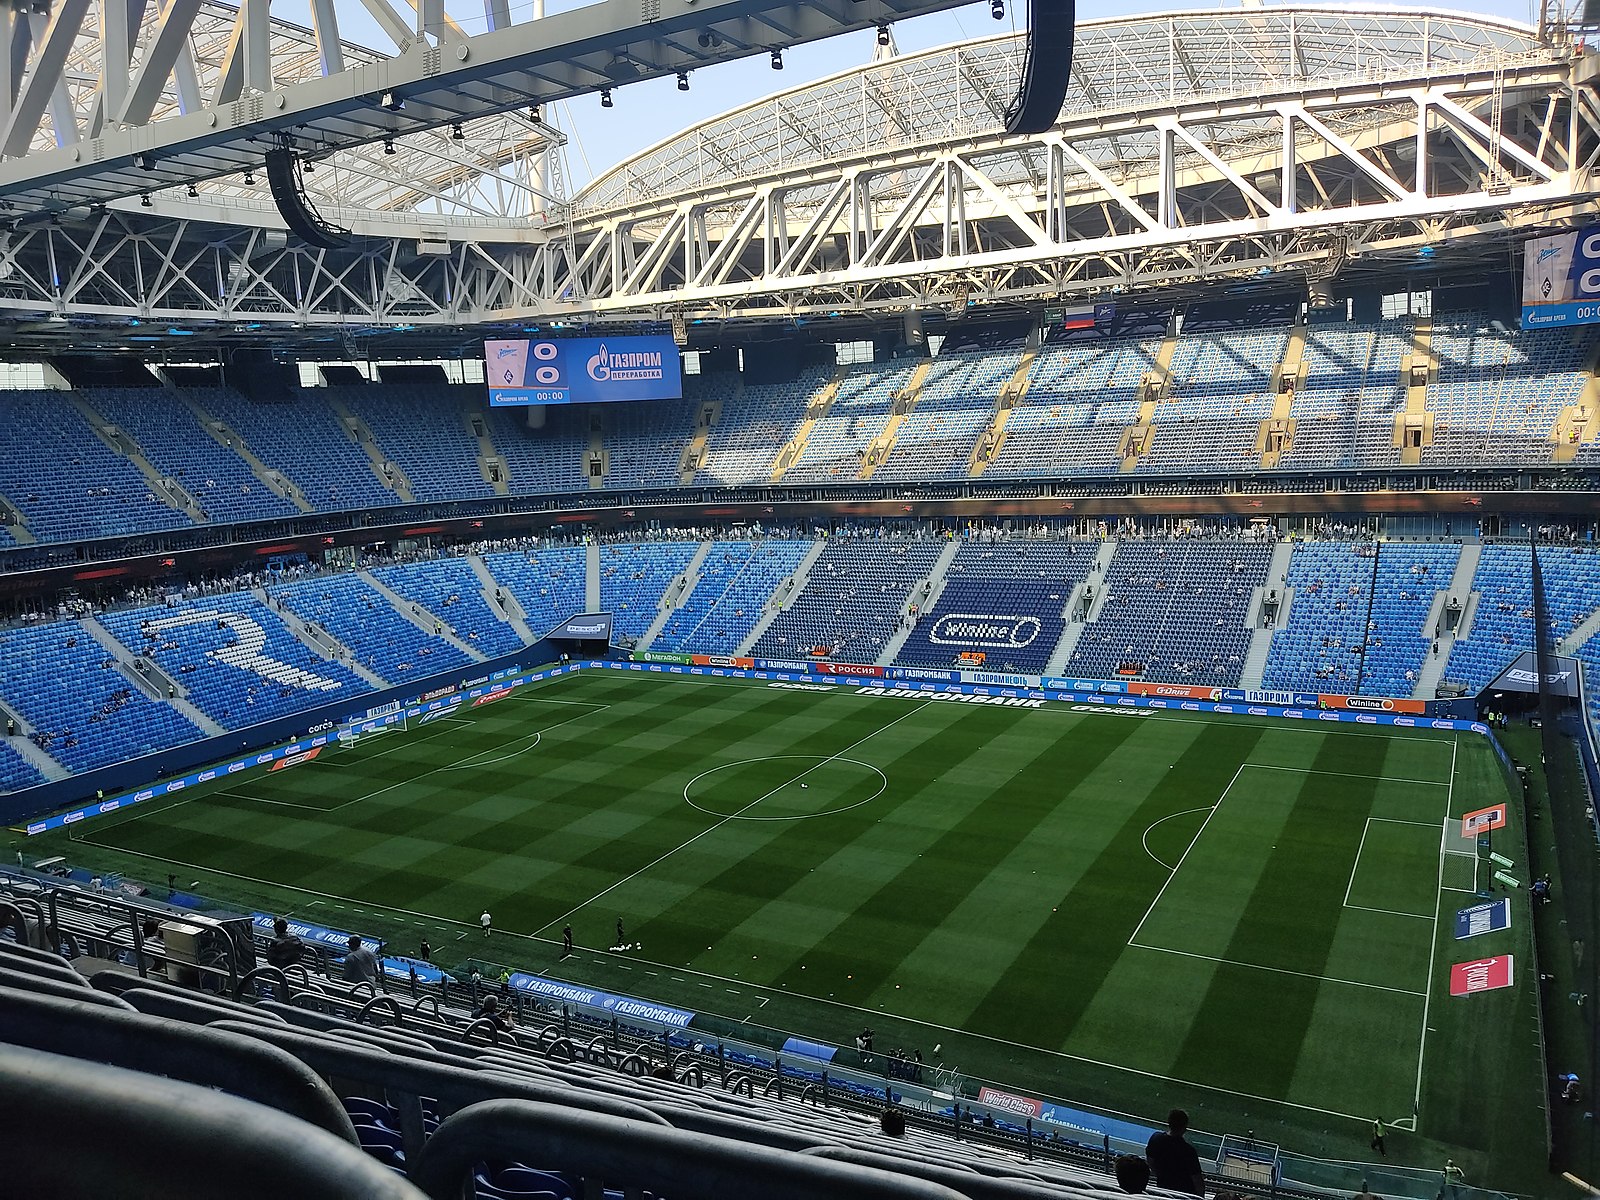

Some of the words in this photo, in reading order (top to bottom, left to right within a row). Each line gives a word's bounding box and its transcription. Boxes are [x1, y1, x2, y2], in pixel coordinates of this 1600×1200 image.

[534, 343, 558, 360] 0
[609, 352, 662, 368] ГАЗПРОМ
[536, 366, 560, 384] 0
[612, 371, 661, 379] ПЕРЕРАБОТКА
[536, 392, 563, 401] 00:00
[838, 666, 875, 675] РОССИЯ
[905, 670, 951, 680] ГАЗПРОМБАНК
[973, 673, 1029, 685] ГАЗПРОМНЕФТЬ
[855, 687, 1047, 708] ГАЗПРОМБАНК
[1249, 691, 1289, 702] ГАЗПРОМ
[1350, 700, 1380, 708] Winline
[527, 980, 595, 1003] ГАЗПРОМБАНК
[615, 1000, 688, 1026] ГАЗПРОМБАНК
[985, 1092, 1010, 1107] World
[1009, 1097, 1034, 1115] Class
